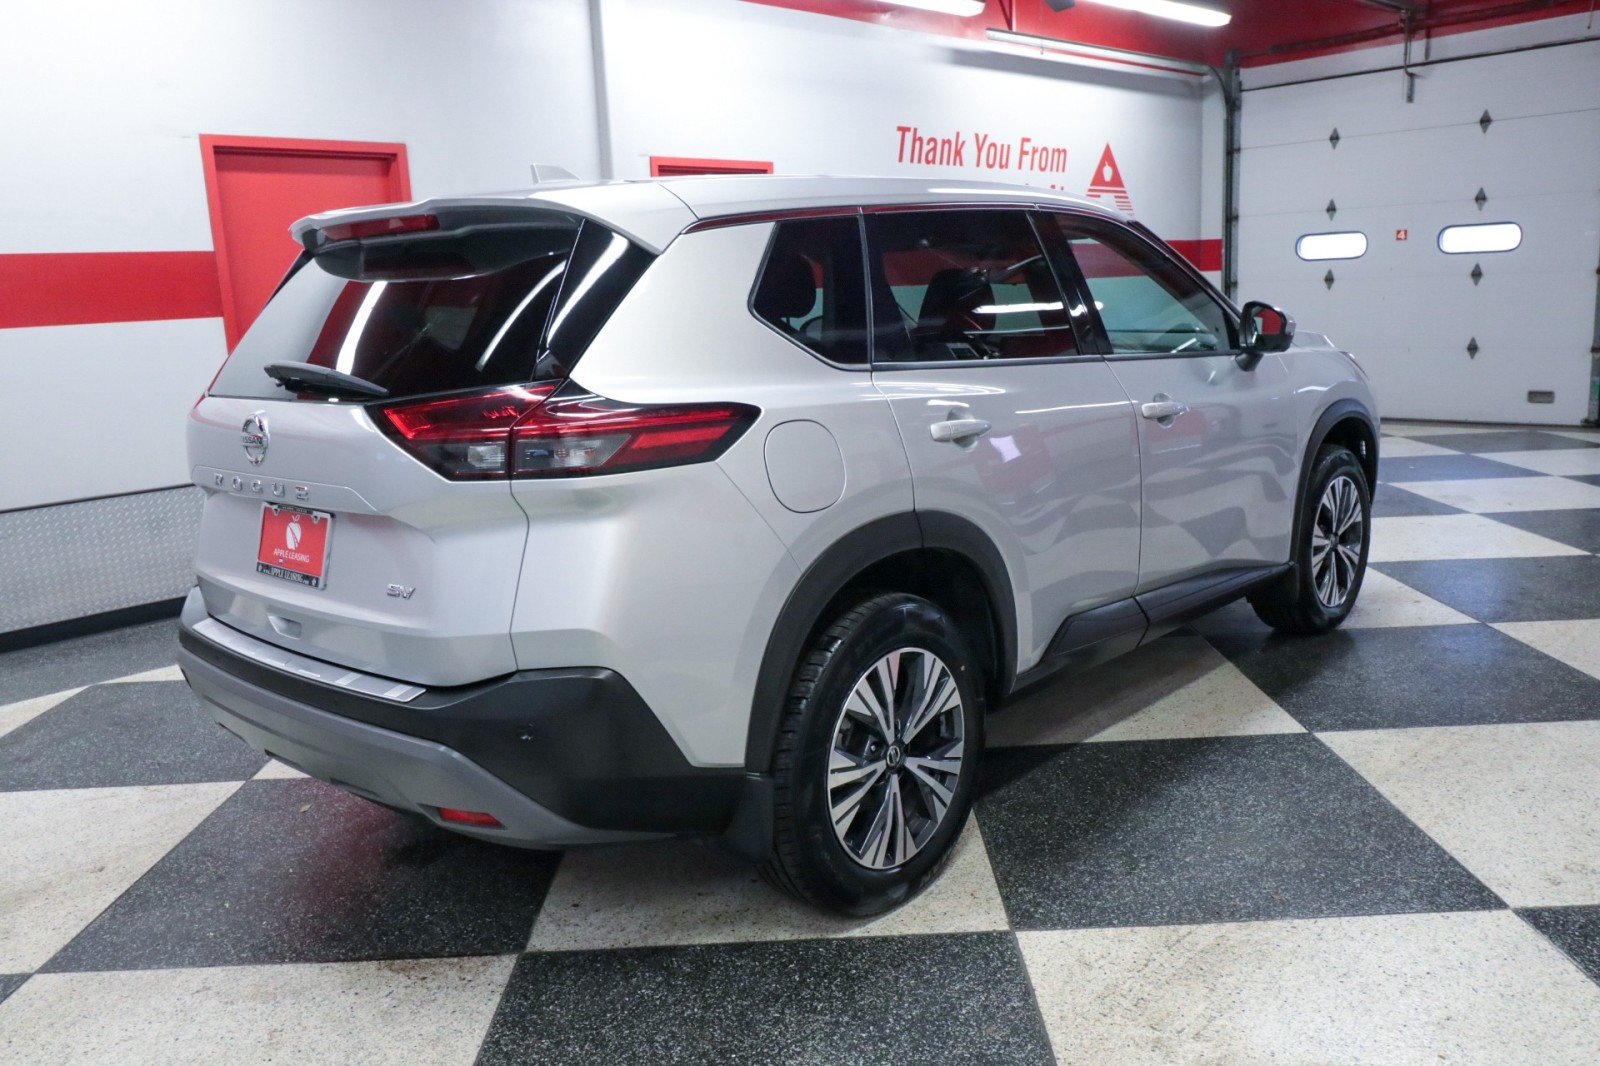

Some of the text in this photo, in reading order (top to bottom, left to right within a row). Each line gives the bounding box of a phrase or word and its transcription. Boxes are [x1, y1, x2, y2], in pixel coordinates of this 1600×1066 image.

[897, 125, 1067, 173] Thank You From
[1397, 230, 1406, 240] 4
[213, 472, 310, 501] ROGUE
[273, 548, 288, 558] APPLE
[288, 551, 310, 563] LEASING
[386, 583, 416, 600] SV
